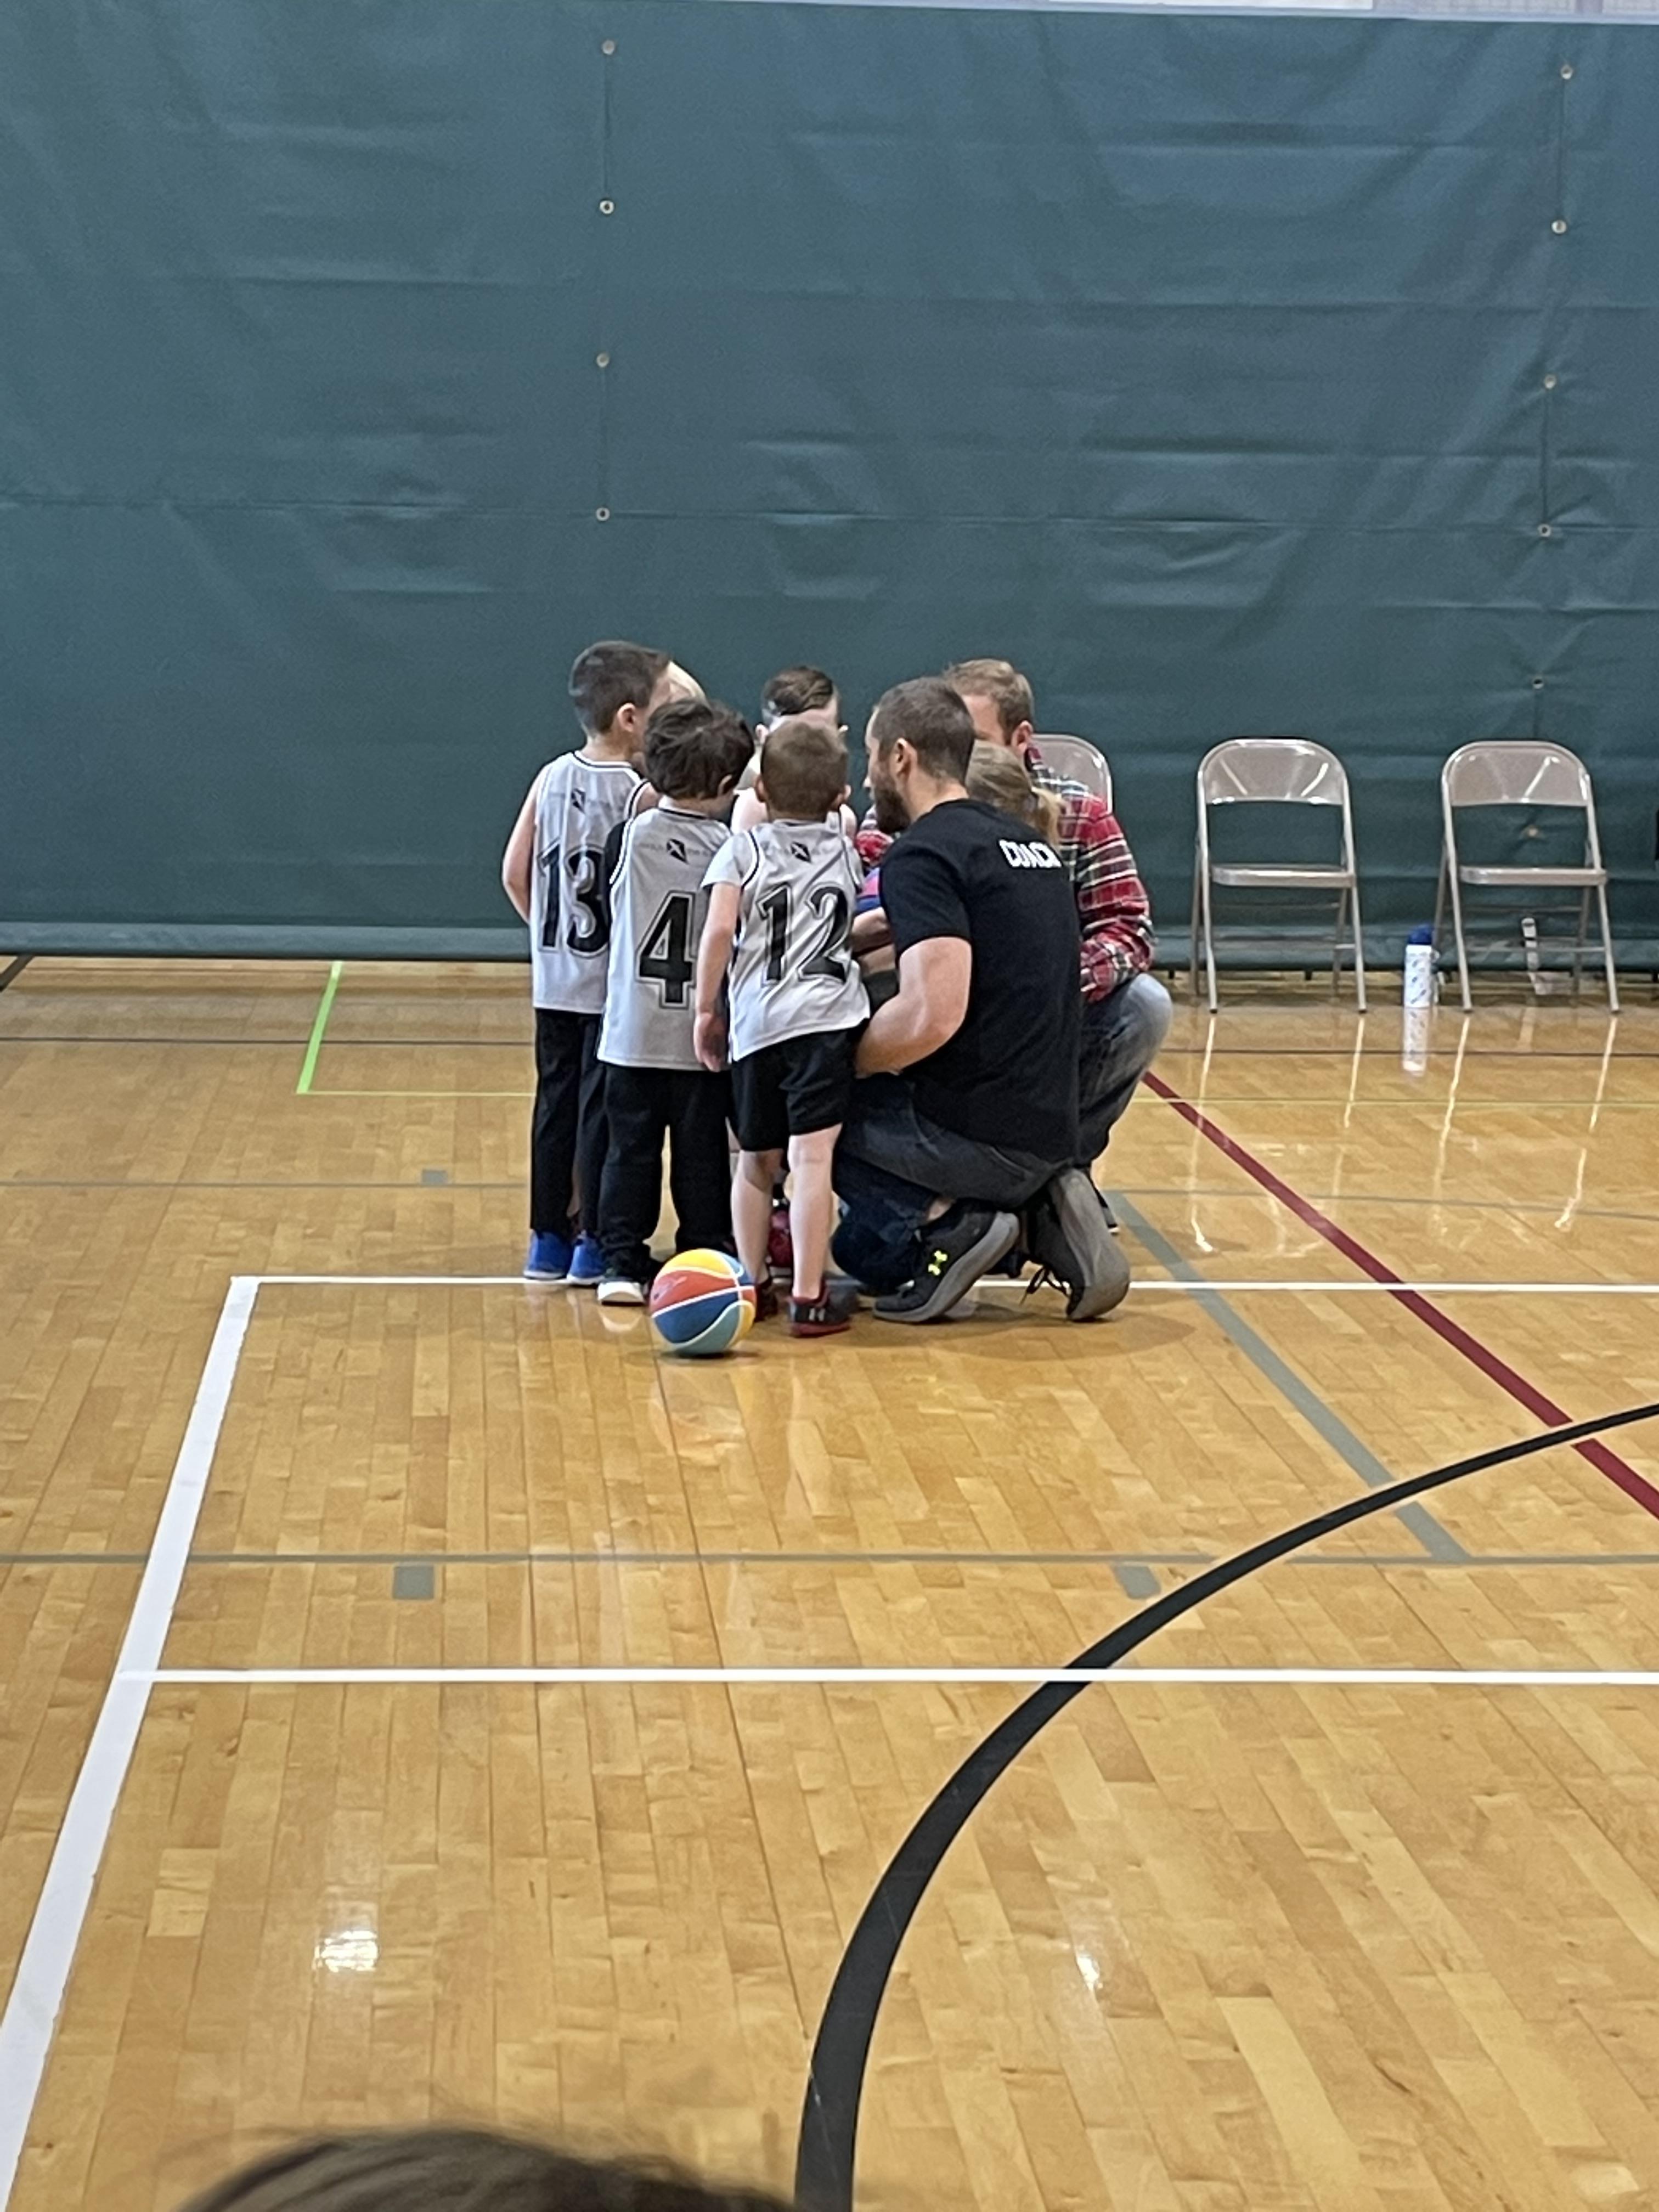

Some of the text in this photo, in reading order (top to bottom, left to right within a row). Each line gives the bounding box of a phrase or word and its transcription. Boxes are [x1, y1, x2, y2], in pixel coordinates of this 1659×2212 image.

[537, 837, 610, 958] 13
[635, 889, 697, 1009] 4
[756, 882, 850, 985] 12
